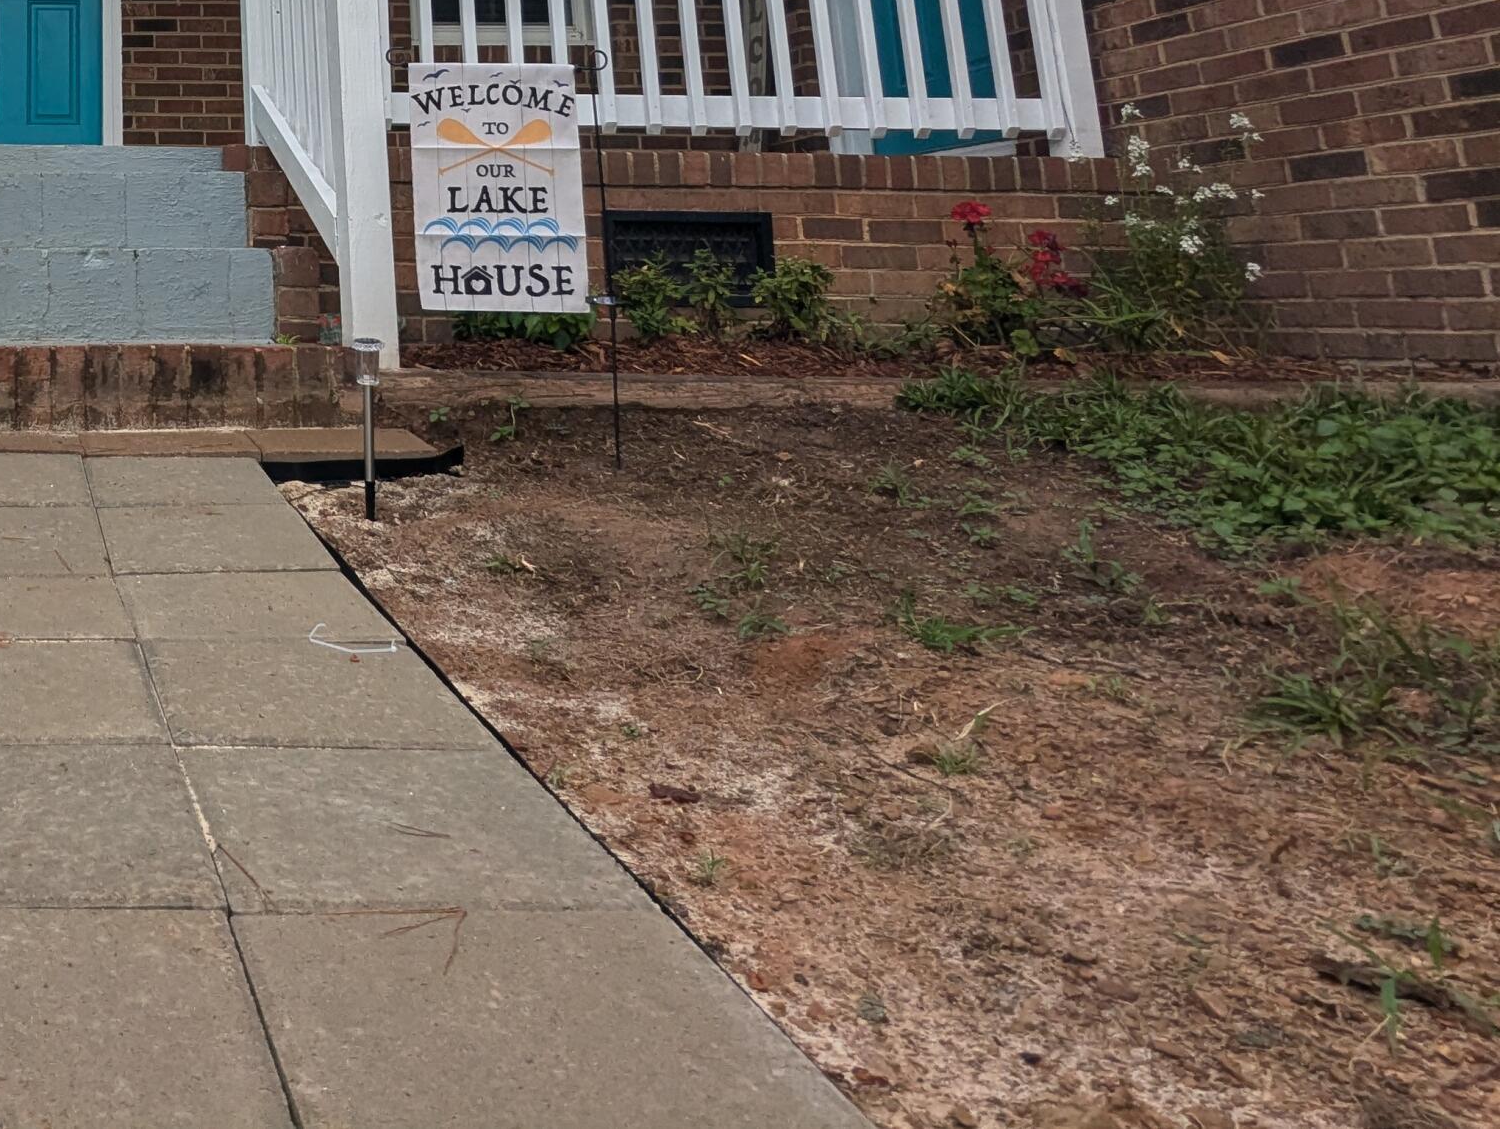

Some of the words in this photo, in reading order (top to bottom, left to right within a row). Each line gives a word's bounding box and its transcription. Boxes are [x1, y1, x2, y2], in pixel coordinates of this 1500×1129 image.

[411, 83, 575, 117] WELCOME
[482, 122, 509, 135] TO
[476, 164, 516, 178] OUR
[447, 186, 548, 213] LAKE
